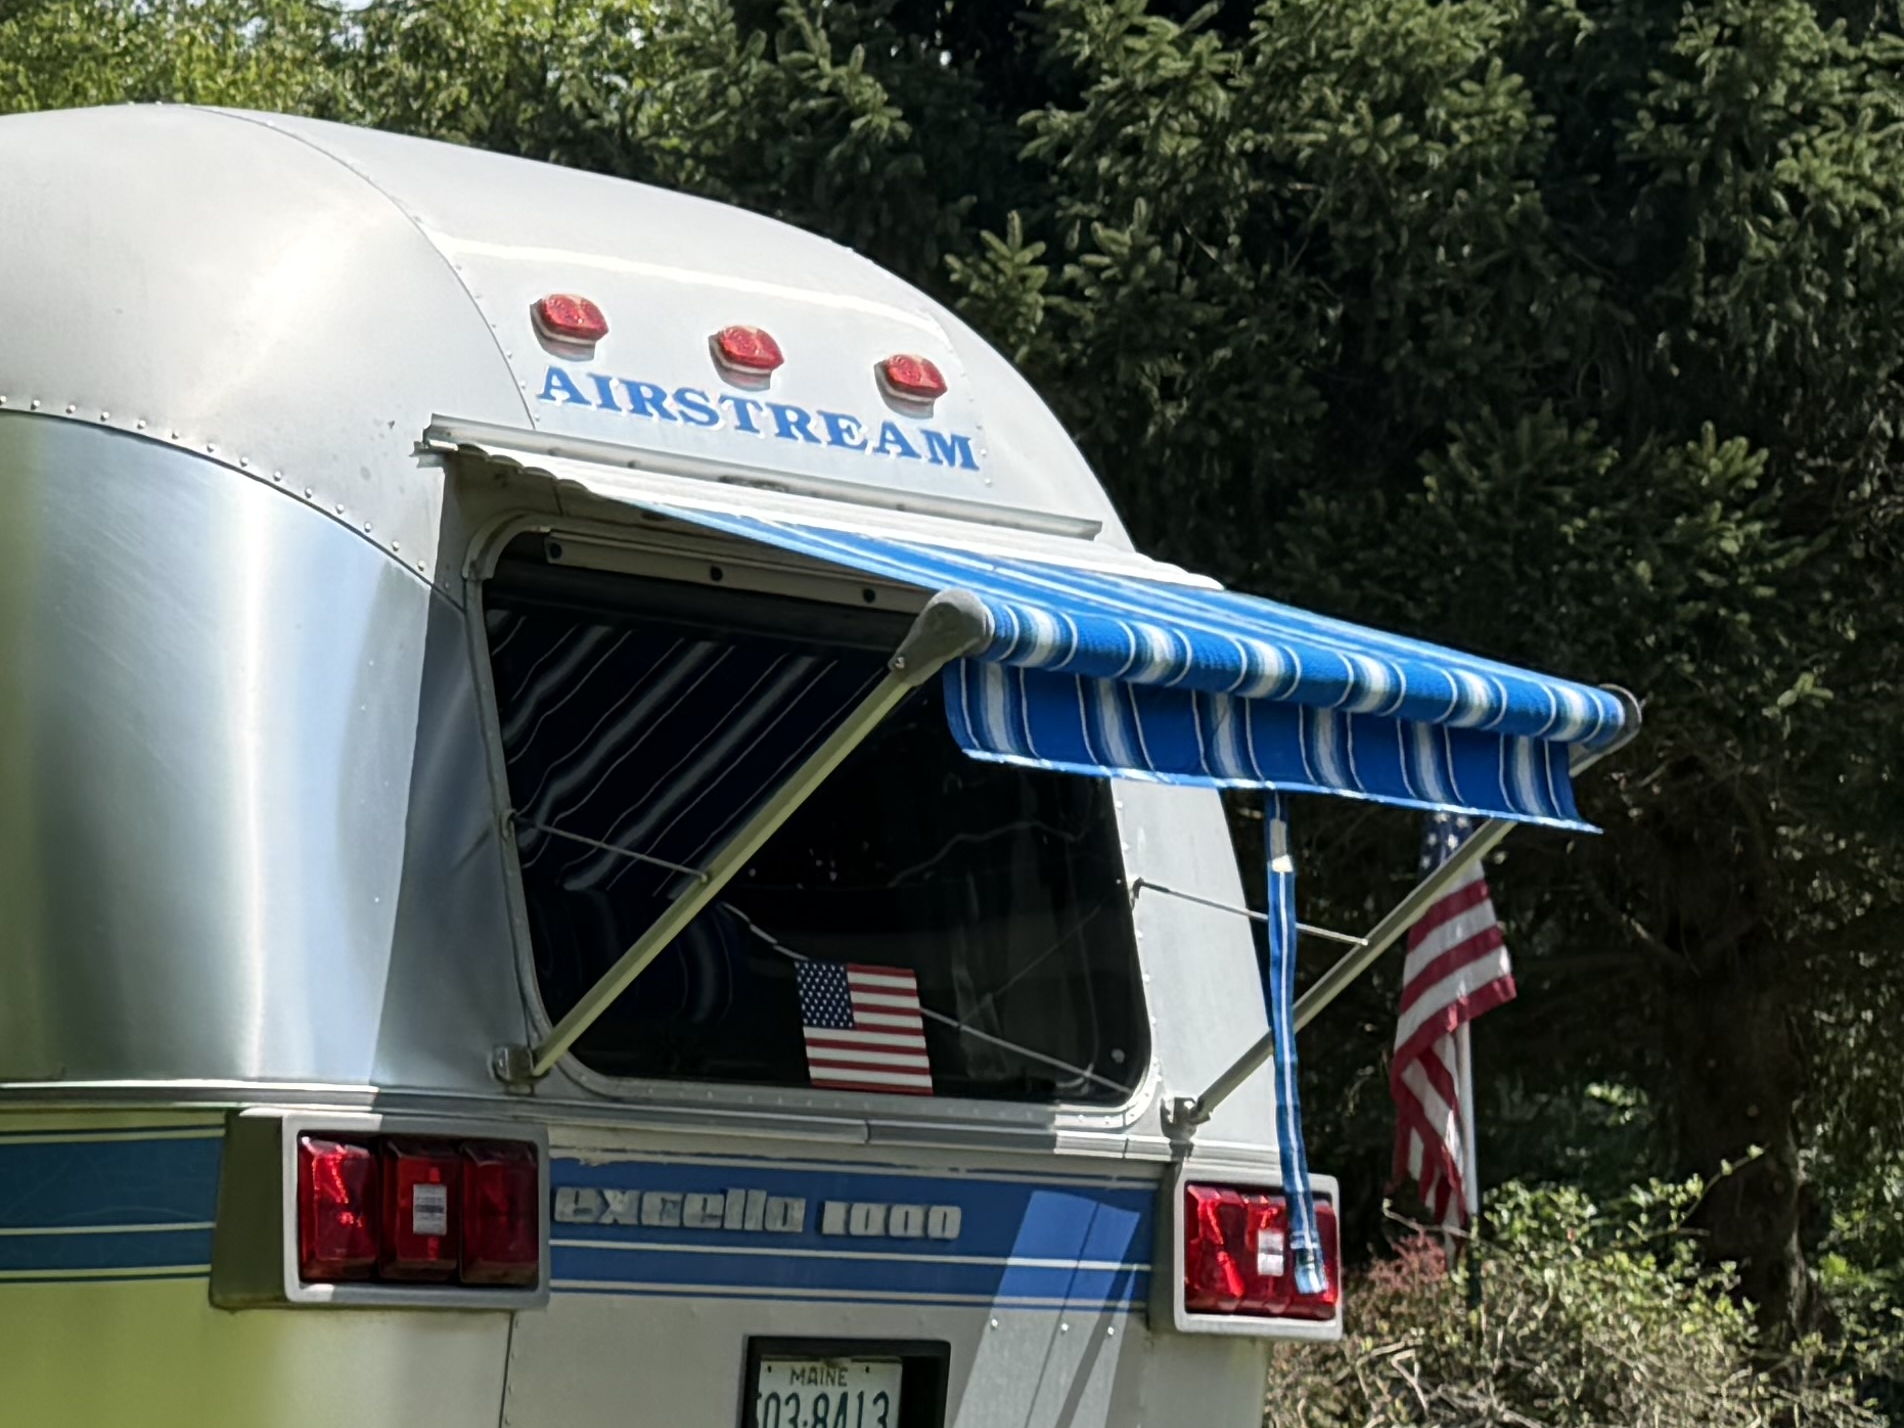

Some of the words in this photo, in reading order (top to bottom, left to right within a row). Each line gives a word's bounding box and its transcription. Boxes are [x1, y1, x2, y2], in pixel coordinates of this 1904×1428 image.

[538, 365, 980, 471] AIRSTREAM
[822, 1200, 962, 1239] 1000
[789, 1366, 848, 1387] MAINE
